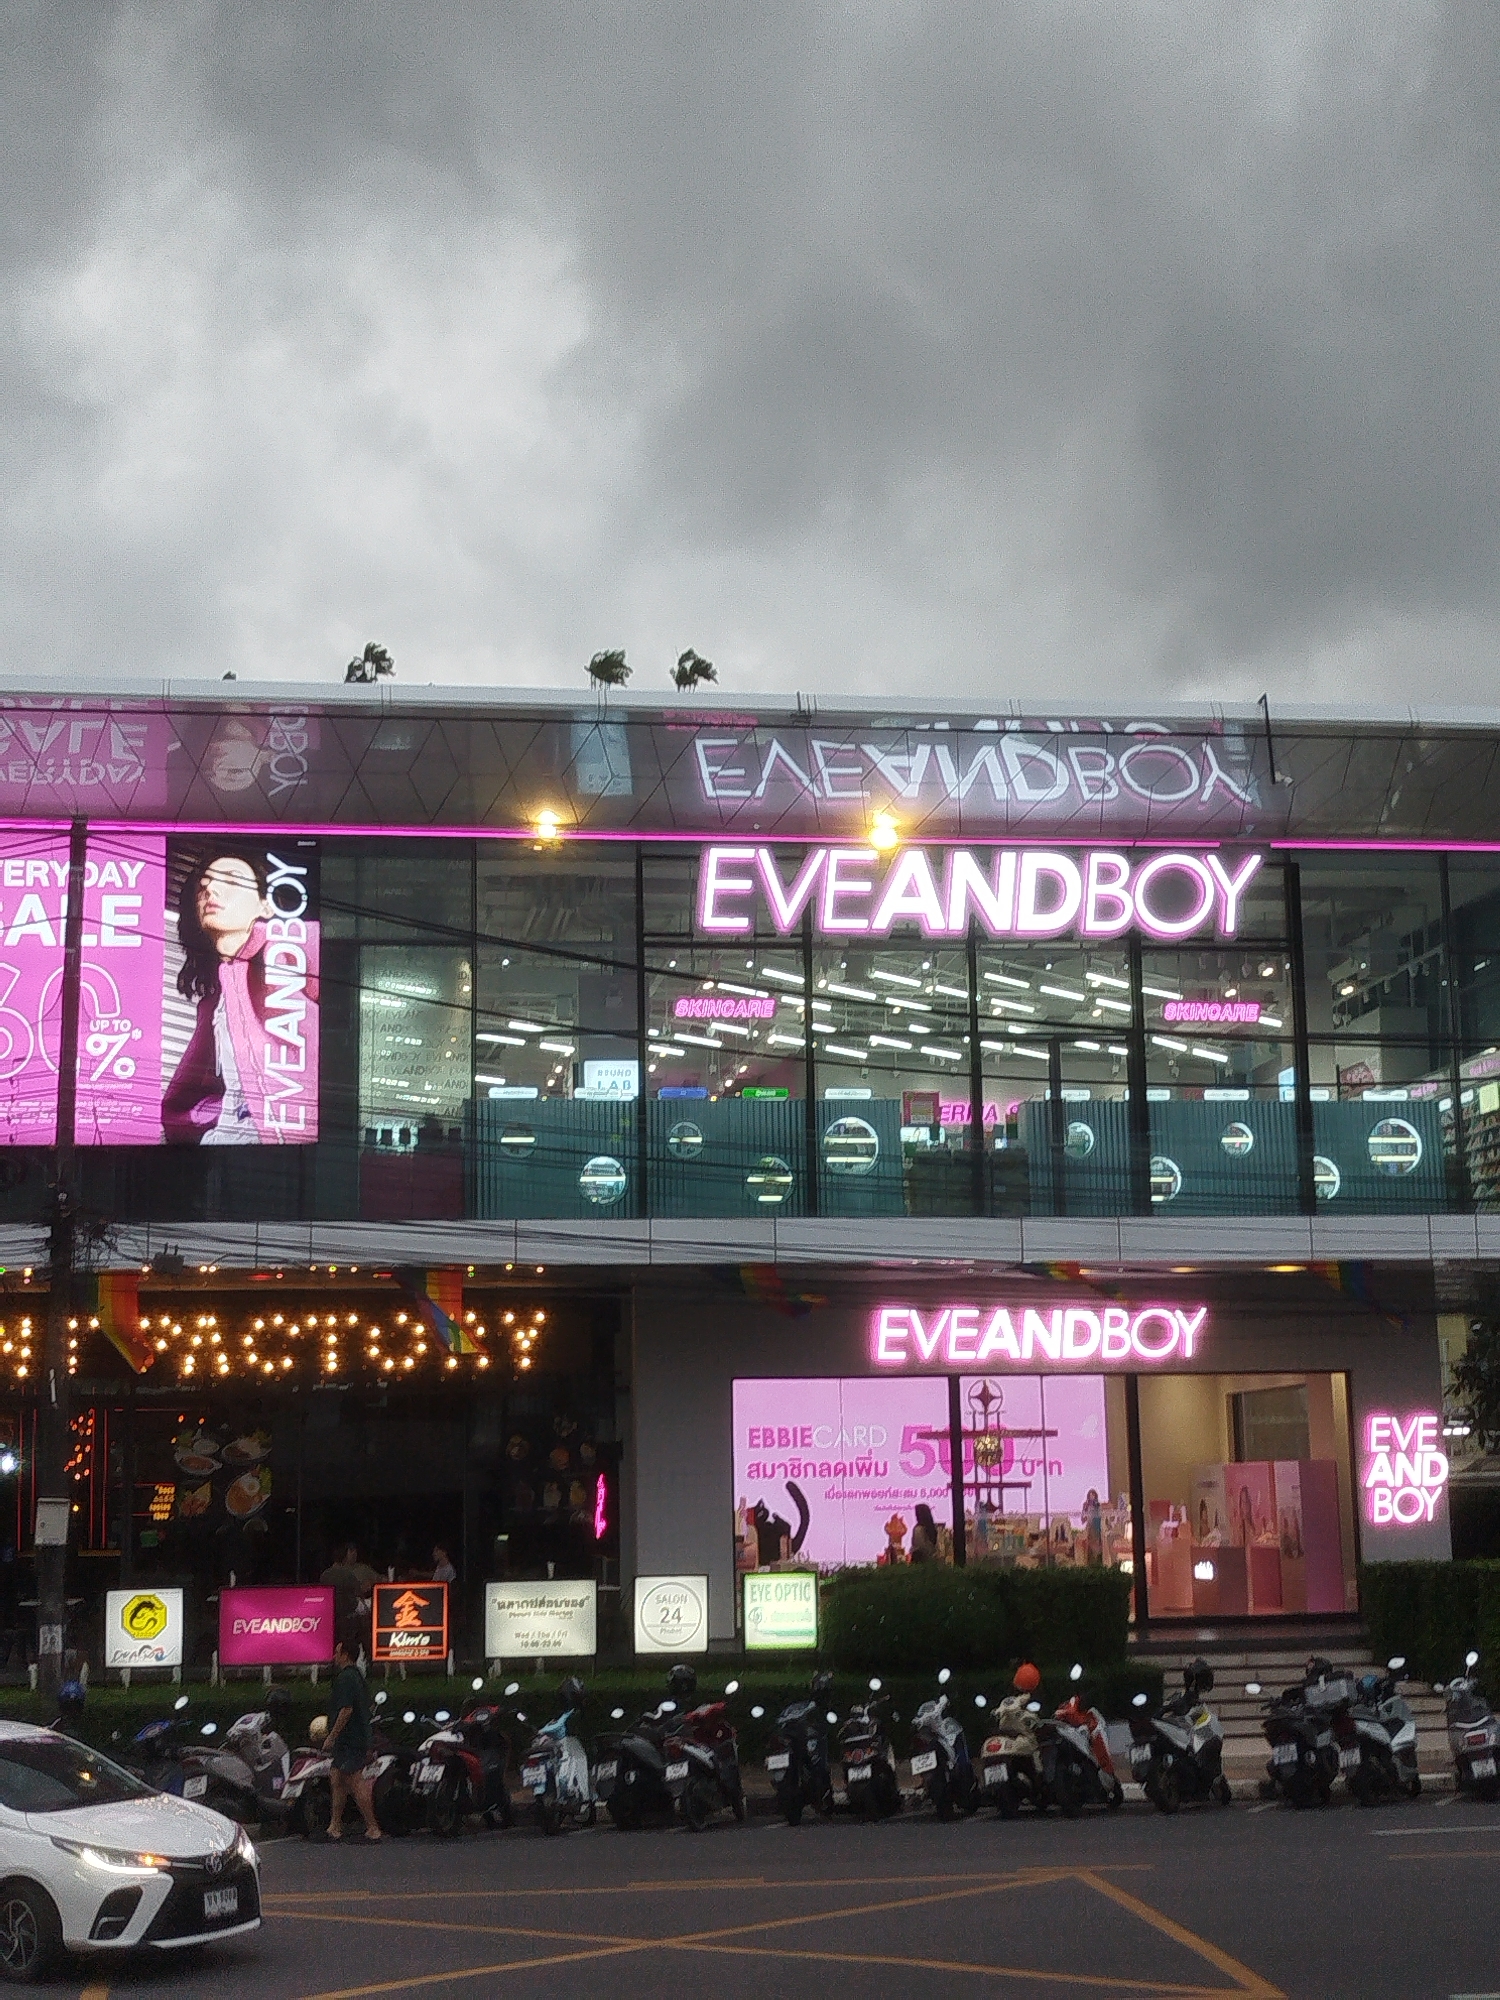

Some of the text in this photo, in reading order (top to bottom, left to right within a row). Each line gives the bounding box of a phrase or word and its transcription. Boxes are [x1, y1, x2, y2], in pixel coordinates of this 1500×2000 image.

[0, 858, 146, 889] ERYDAY
[702, 847, 1262, 933] EVEANDBOY
[0, 893, 143, 948] ALE
[264, 852, 308, 1131] EVEANDBOY
[675, 998, 776, 1019] SKINCARE
[1164, 1002, 1260, 1023] SKINCARE
[90, 1019, 132, 1032] UP TO
[938, 1103, 999, 1123] ERA
[877, 1306, 1208, 1360] EVEANDBOY
[1370, 1416, 1438, 1453] EVE
[747, 1448, 889, 1479] สมาชิกลดเพิ่ม
[1366, 1452, 1449, 1488] AND
[1372, 1487, 1443, 1523] BOY
[655, 1593, 688, 1605] SALON
[750, 1581, 812, 1601] EYE OPTIC
[232, 1617, 322, 1635] EVEANDBOY
[659, 1606, 683, 1624] 24
